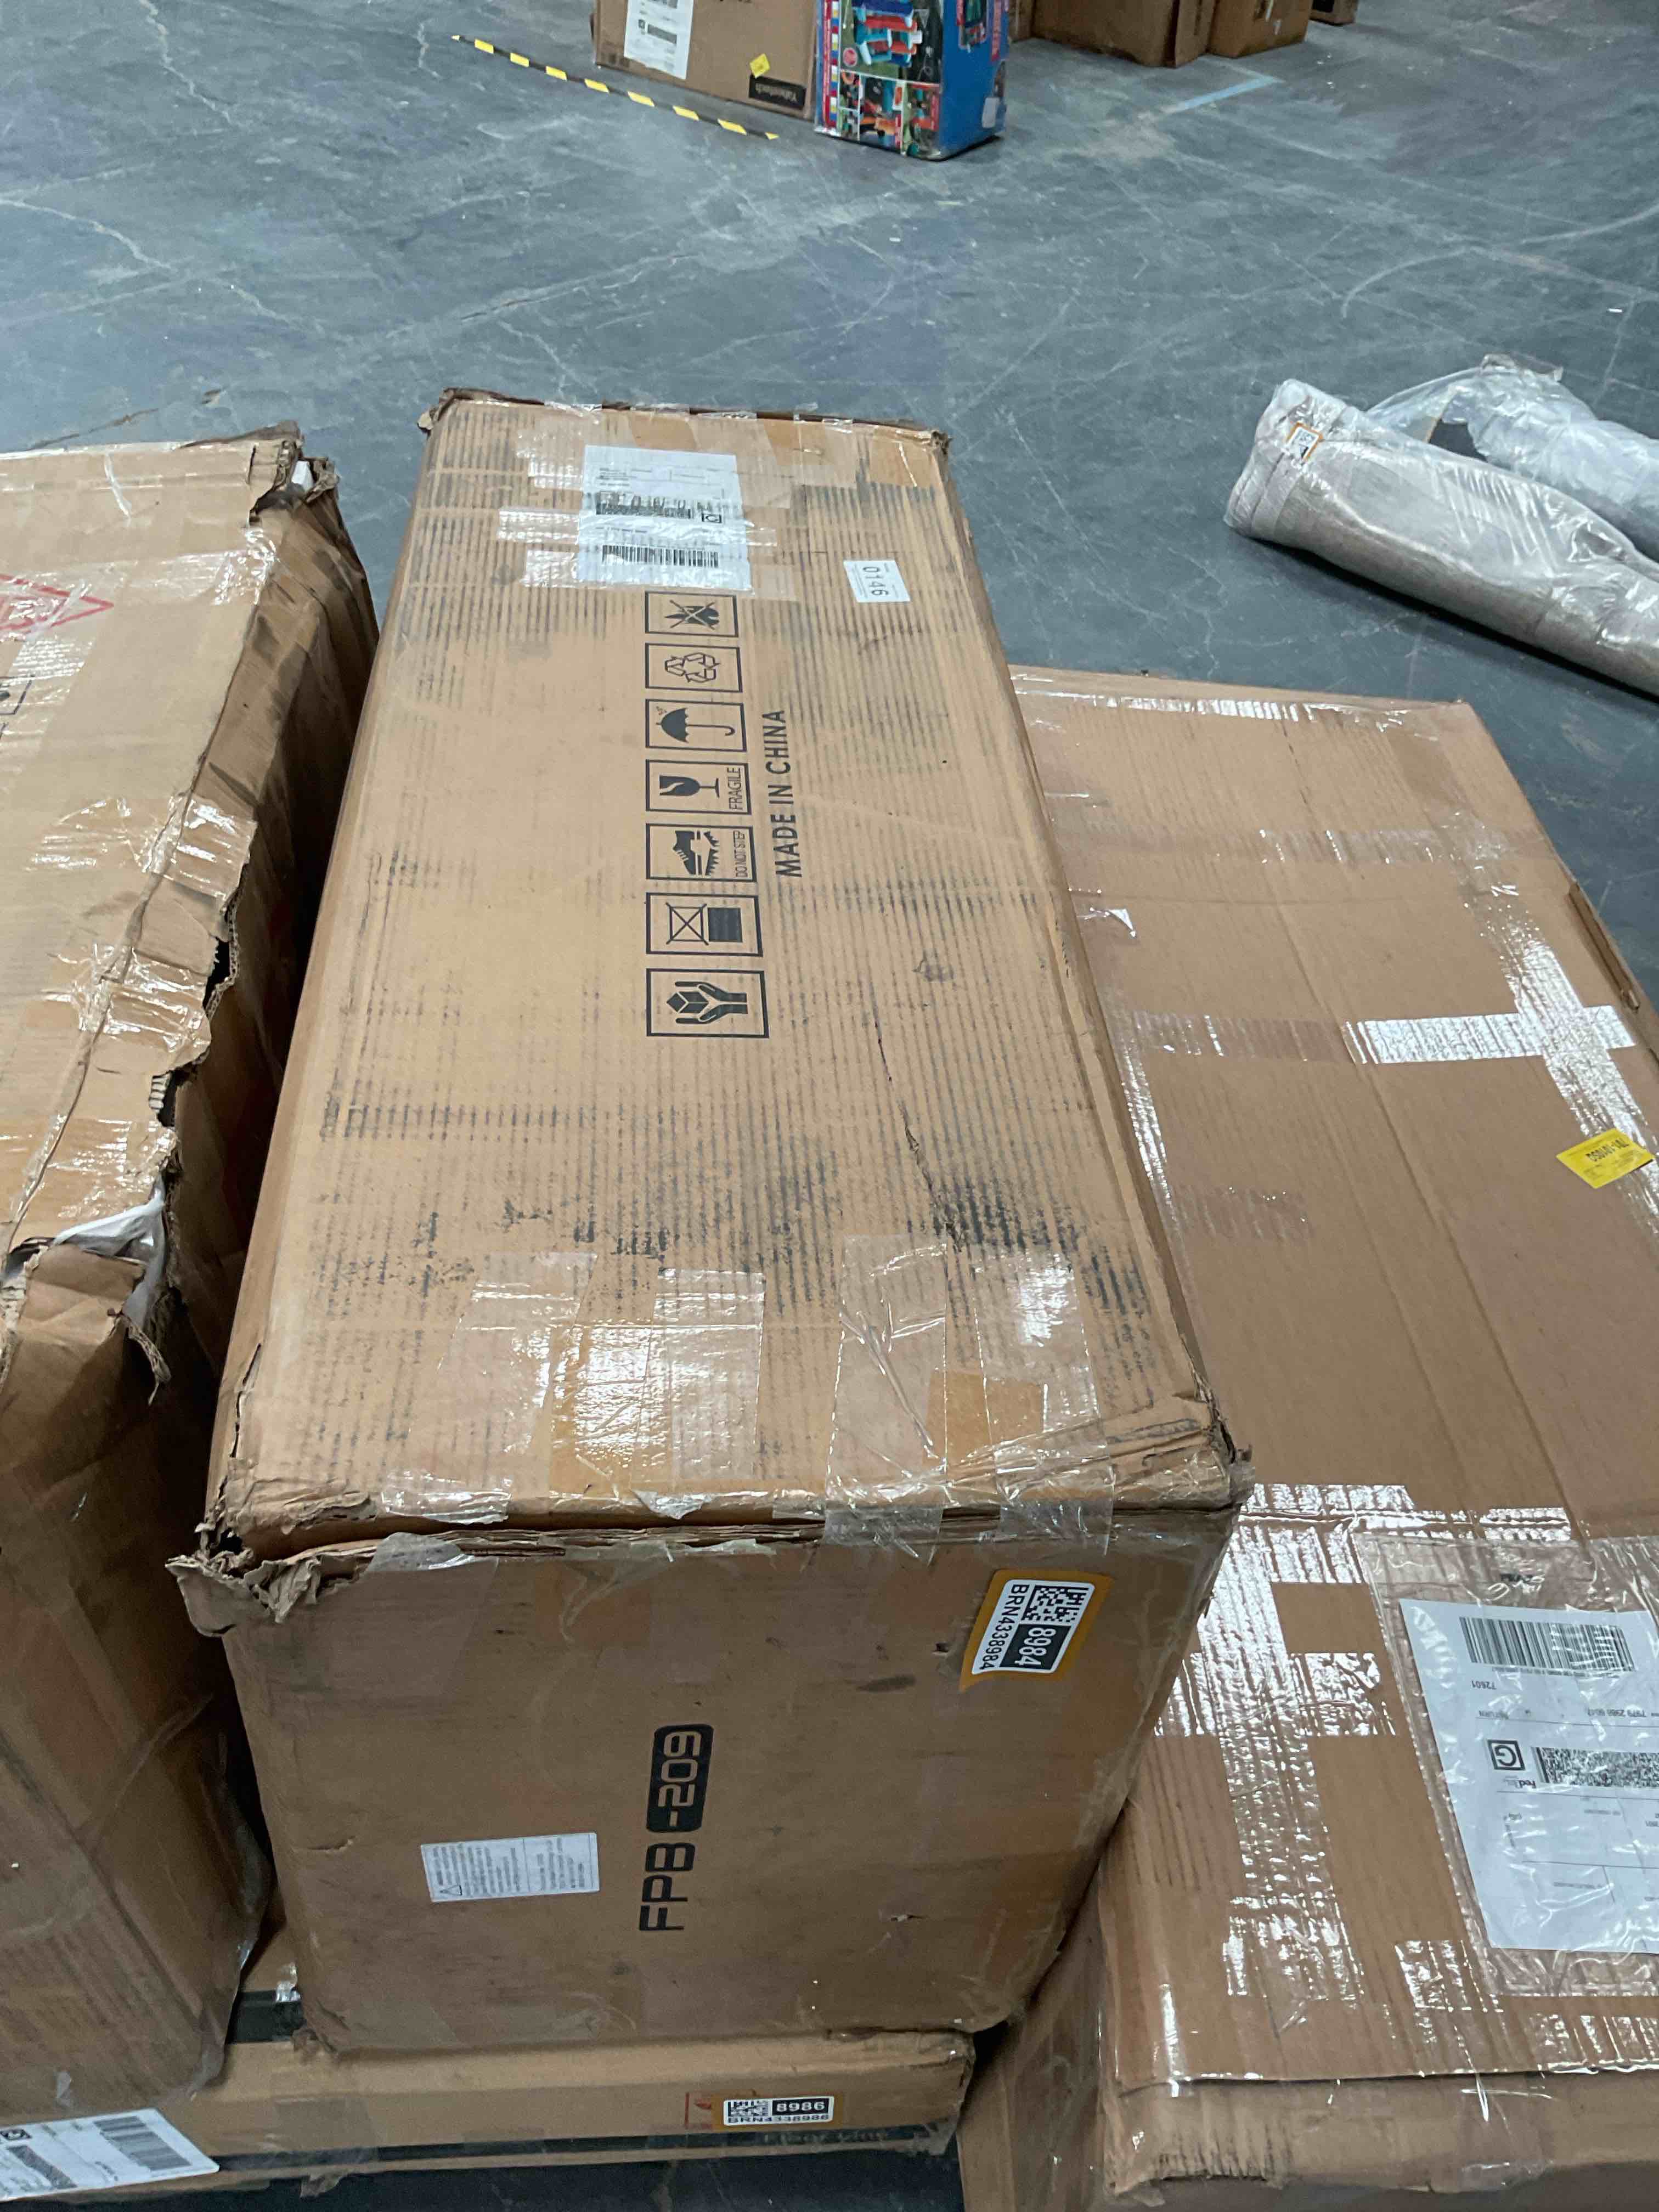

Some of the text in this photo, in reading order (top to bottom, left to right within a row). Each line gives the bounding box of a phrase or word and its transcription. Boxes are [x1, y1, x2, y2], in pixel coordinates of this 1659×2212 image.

[863, 567, 889, 596] 0146
[727, 767, 743, 810] FRAGILE
[762, 710, 803, 877] MADE IN CHINA
[733, 830, 748, 878] DO NOT STEP
[979, 1584, 1030, 1670] BRN4338984
[1014, 1627, 1057, 1666] 8984
[1495, 1745, 1517, 1767] G
[776, 2101, 825, 2112] 8986
